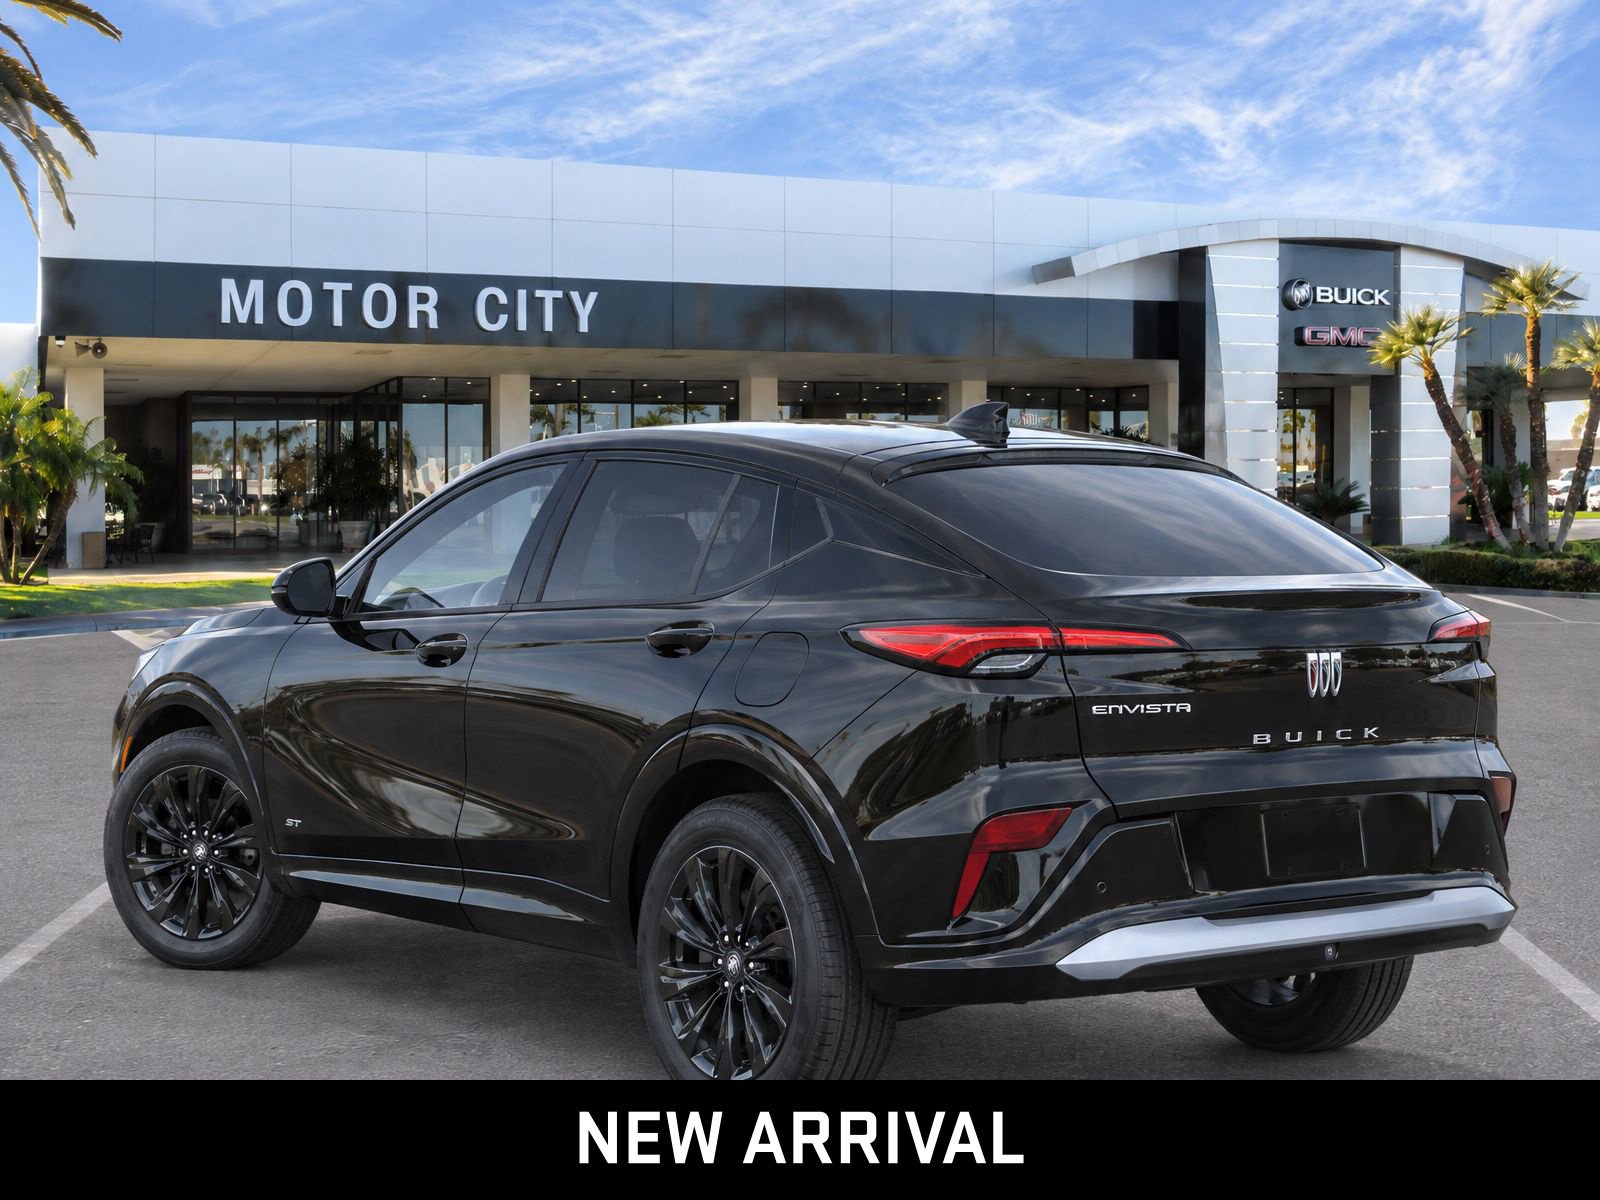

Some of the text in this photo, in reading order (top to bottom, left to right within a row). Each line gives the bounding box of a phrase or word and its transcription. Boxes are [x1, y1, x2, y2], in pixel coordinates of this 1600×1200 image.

[221, 278, 599, 333] MOTOR CITY
[1316, 286, 1392, 306] BUICK
[1091, 702, 1192, 715] ENVISTA
[1252, 726, 1380, 745] BUICK
[285, 818, 302, 828] ST
